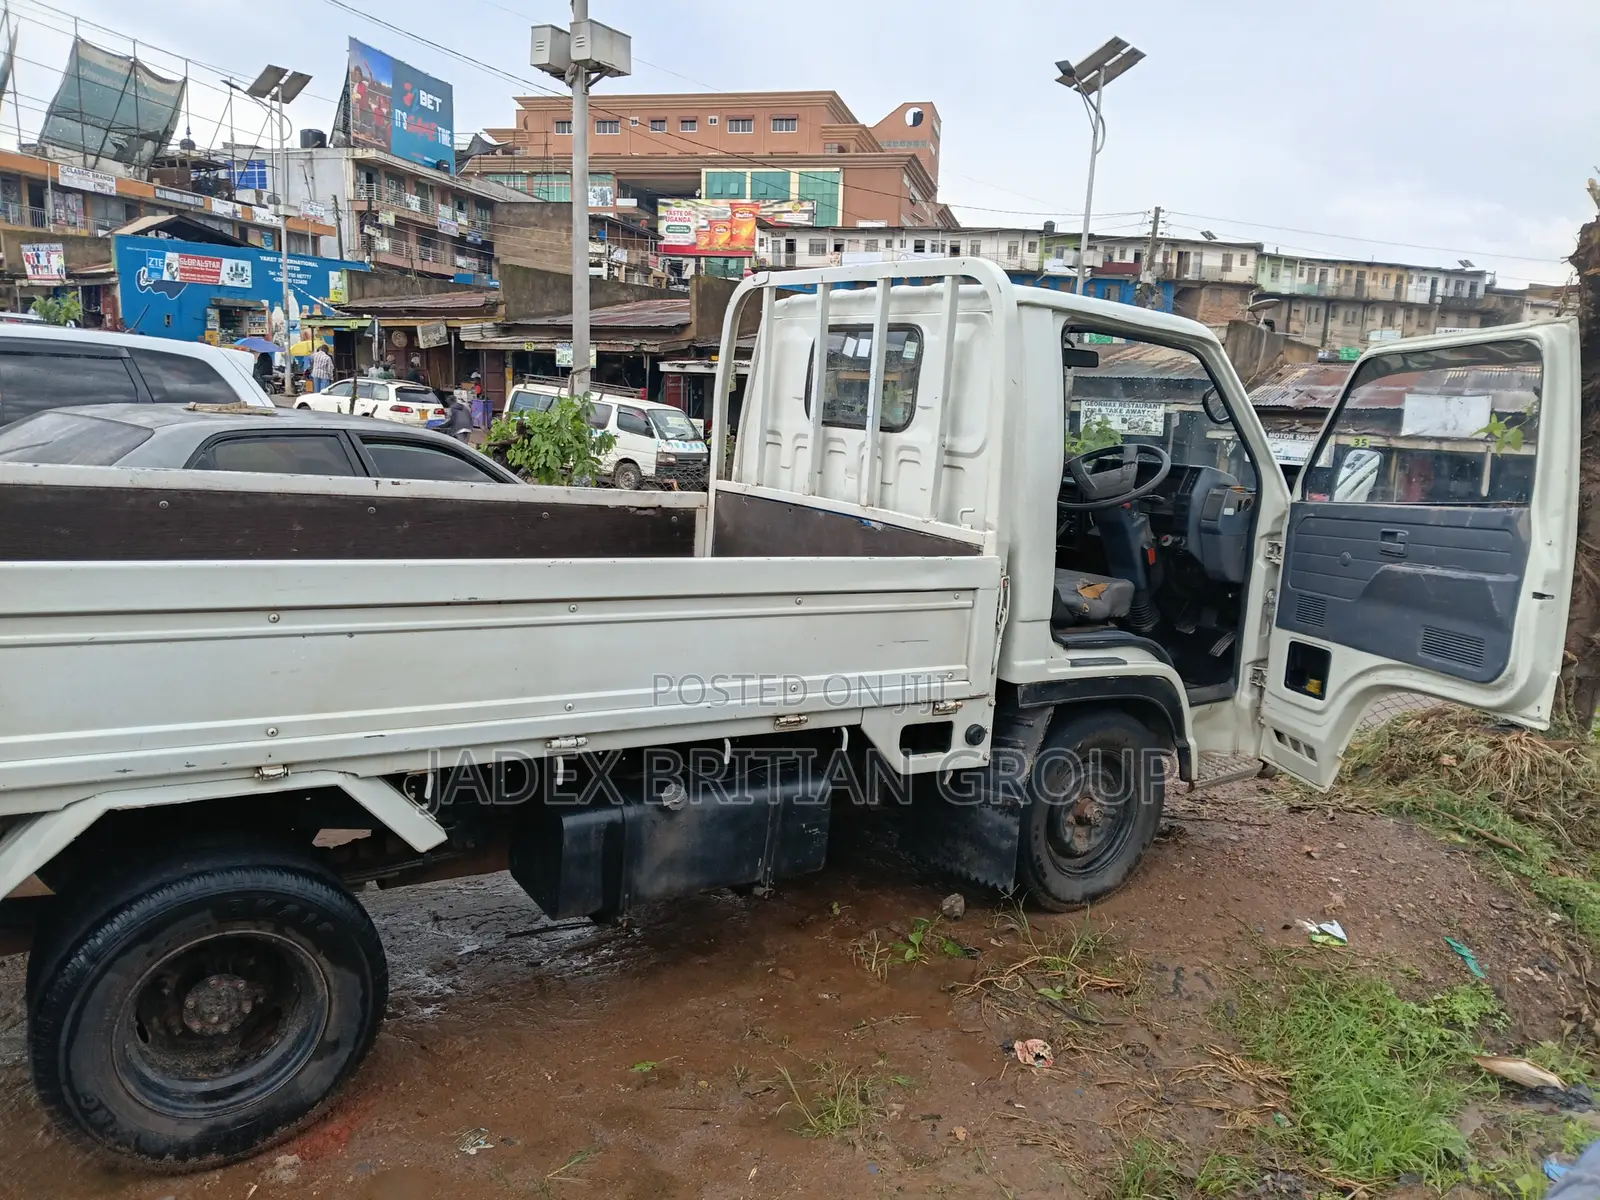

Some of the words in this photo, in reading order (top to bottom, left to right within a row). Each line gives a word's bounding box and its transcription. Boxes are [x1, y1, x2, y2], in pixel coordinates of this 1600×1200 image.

[420, 90, 442, 112] BET
[437, 126, 452, 148] TIME
[66, 166, 91, 178] CLASSIC
[91, 173, 115, 183] BRANDS
[148, 257, 164, 267] ZTE
[1118, 402, 1162, 410] RESTAURANT
[1268, 432, 1294, 440] MOTOR
[1354, 438, 1368, 446] 35
